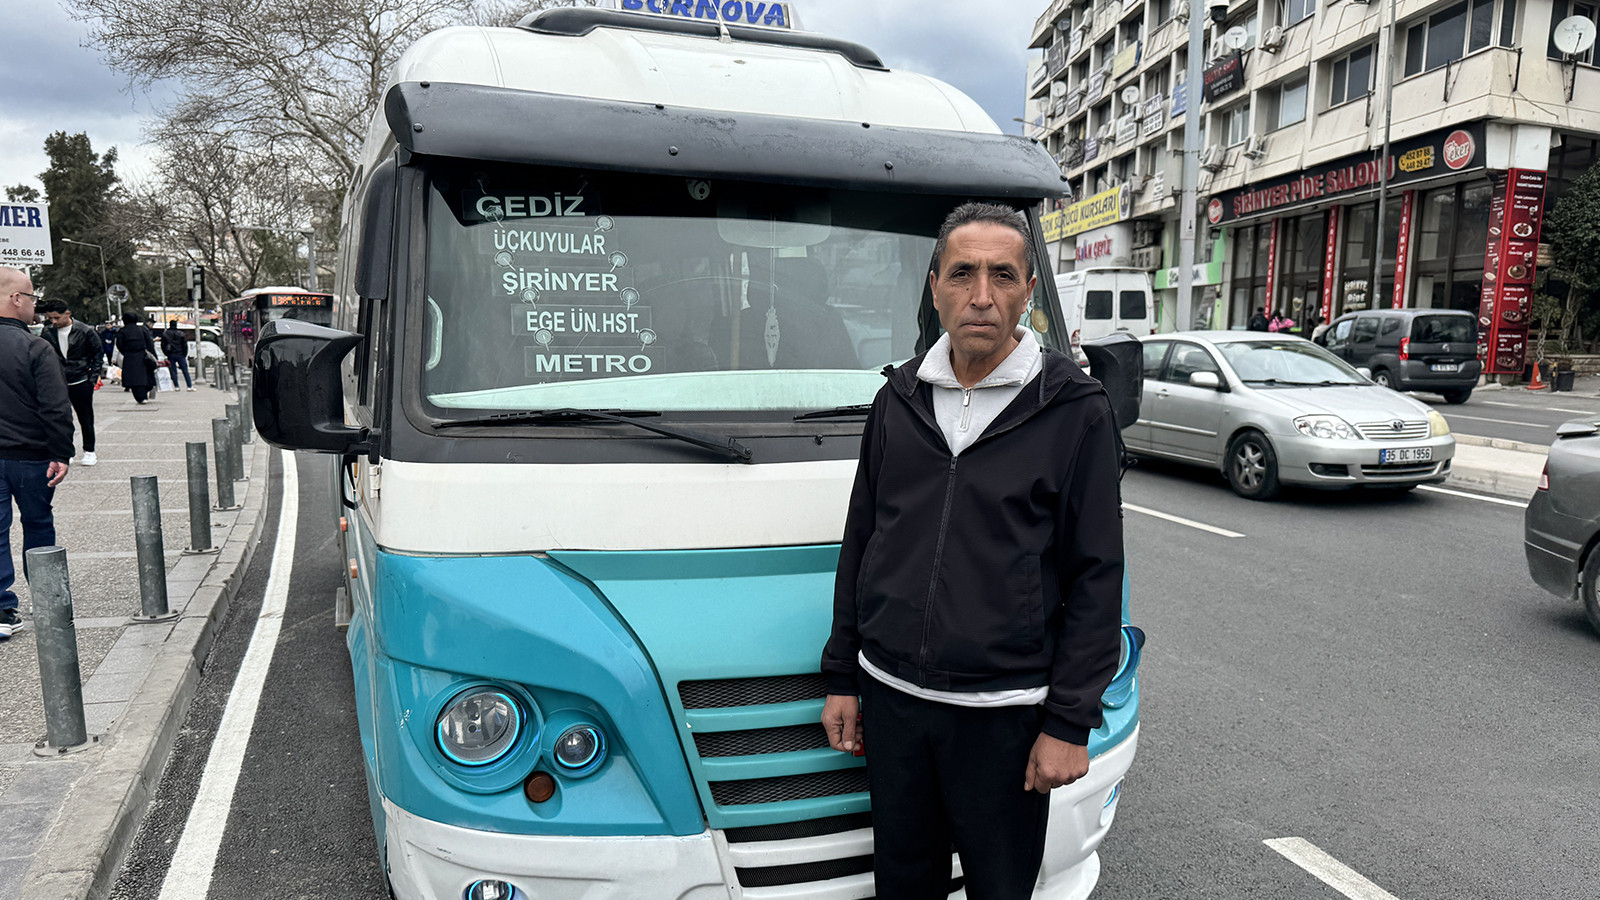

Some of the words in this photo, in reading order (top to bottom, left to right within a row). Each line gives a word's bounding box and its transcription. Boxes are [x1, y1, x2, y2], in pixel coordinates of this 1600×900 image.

[1291, 174, 1325, 202] PİDE
[475, 192, 586, 217] GEDİZ
[1080, 193, 1117, 221] KURSLARI
[1, 248, 18, 256] 448
[20, 248, 32, 257] 66
[34, 249, 46, 257] 48
[494, 229, 606, 255] ÜÇKUYULAR
[502, 268, 619, 295] ŞİRİNYER
[526, 311, 566, 332] EGE
[535, 354, 652, 373] METRO
[1386, 450, 1395, 461] 35
[1400, 449, 1410, 460] DC
[1413, 447, 1430, 460] 1956
